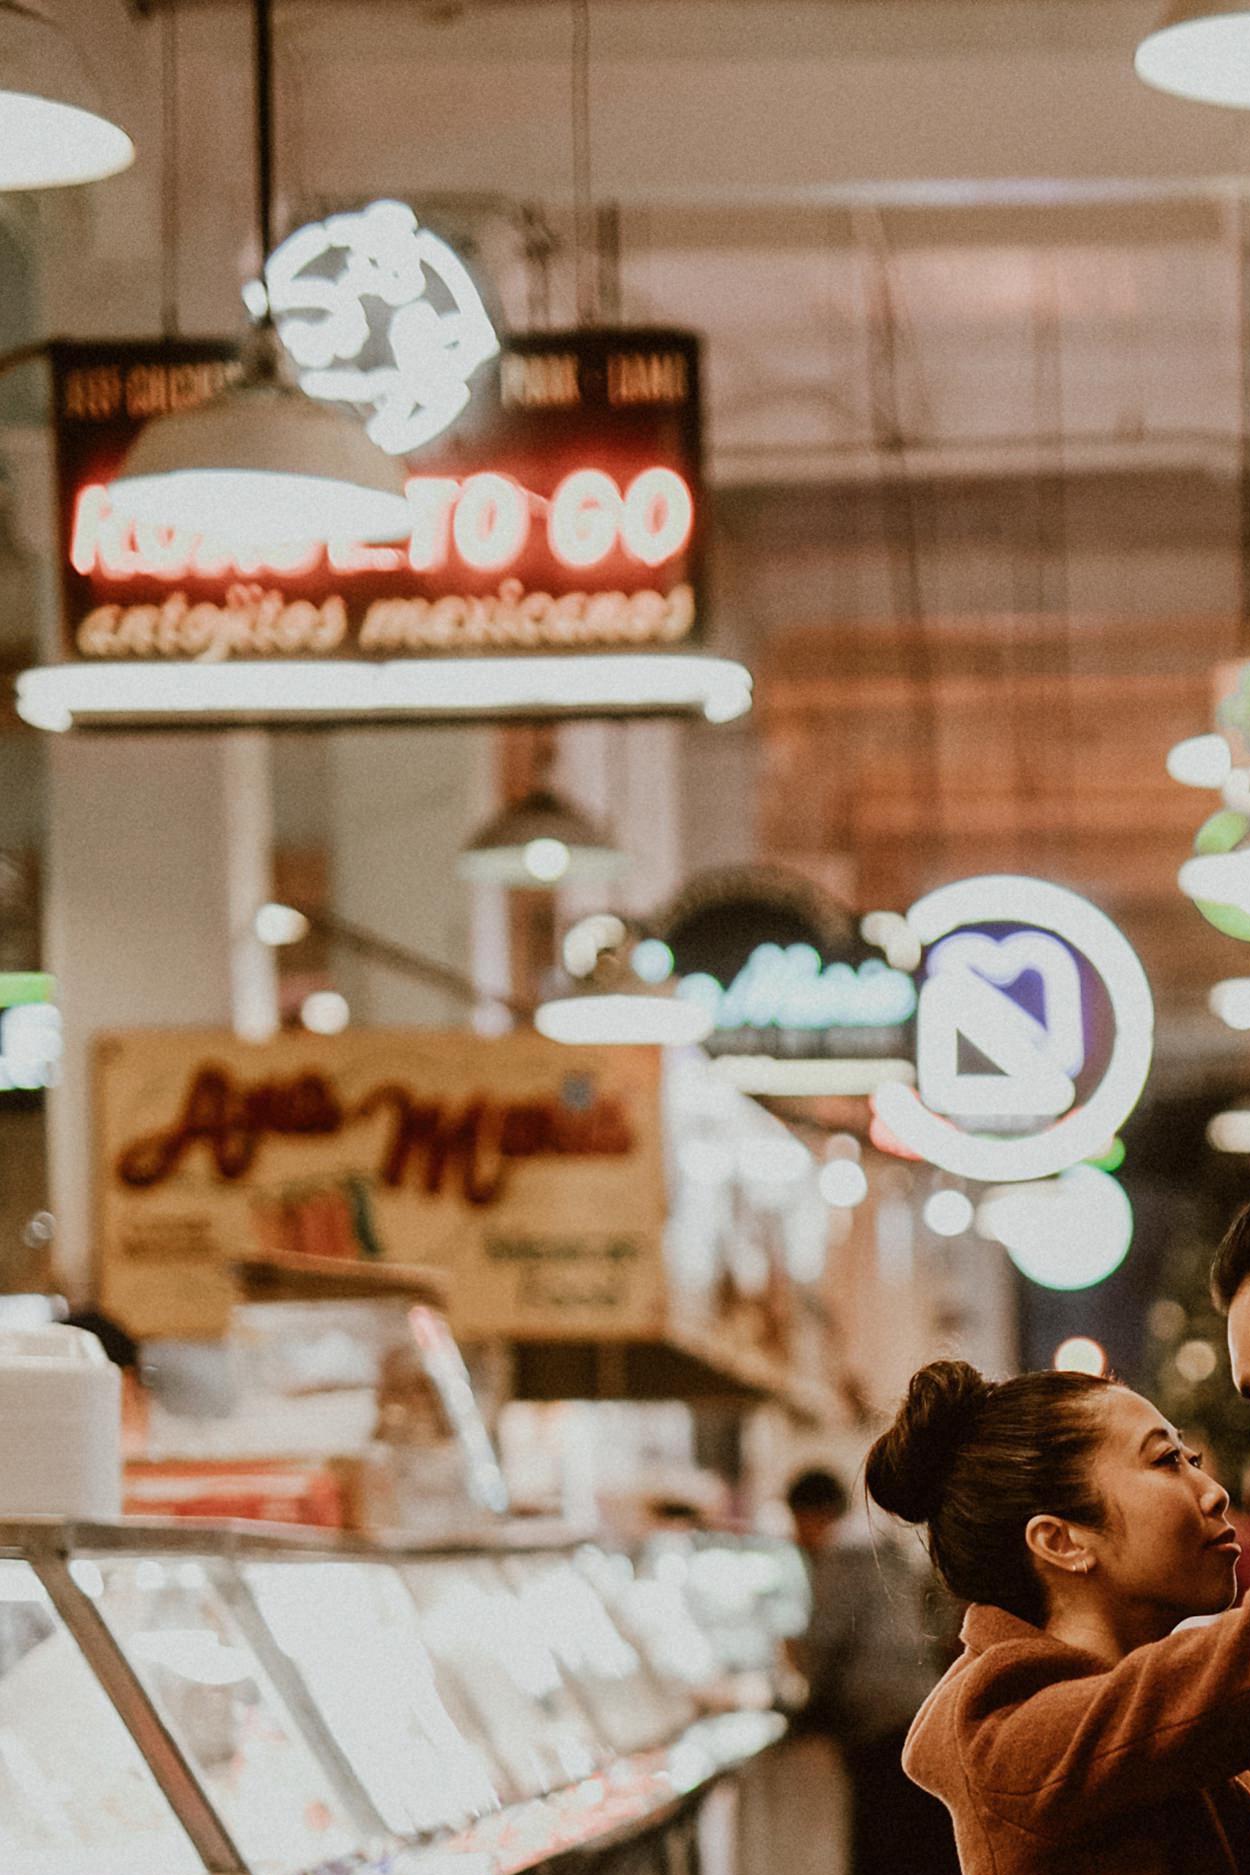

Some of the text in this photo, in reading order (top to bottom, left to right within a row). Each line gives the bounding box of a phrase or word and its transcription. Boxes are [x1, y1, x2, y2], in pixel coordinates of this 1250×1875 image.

[404, 472, 529, 570] TO
[547, 467, 692, 567] GO
[358, 577, 695, 650] mexicanos
